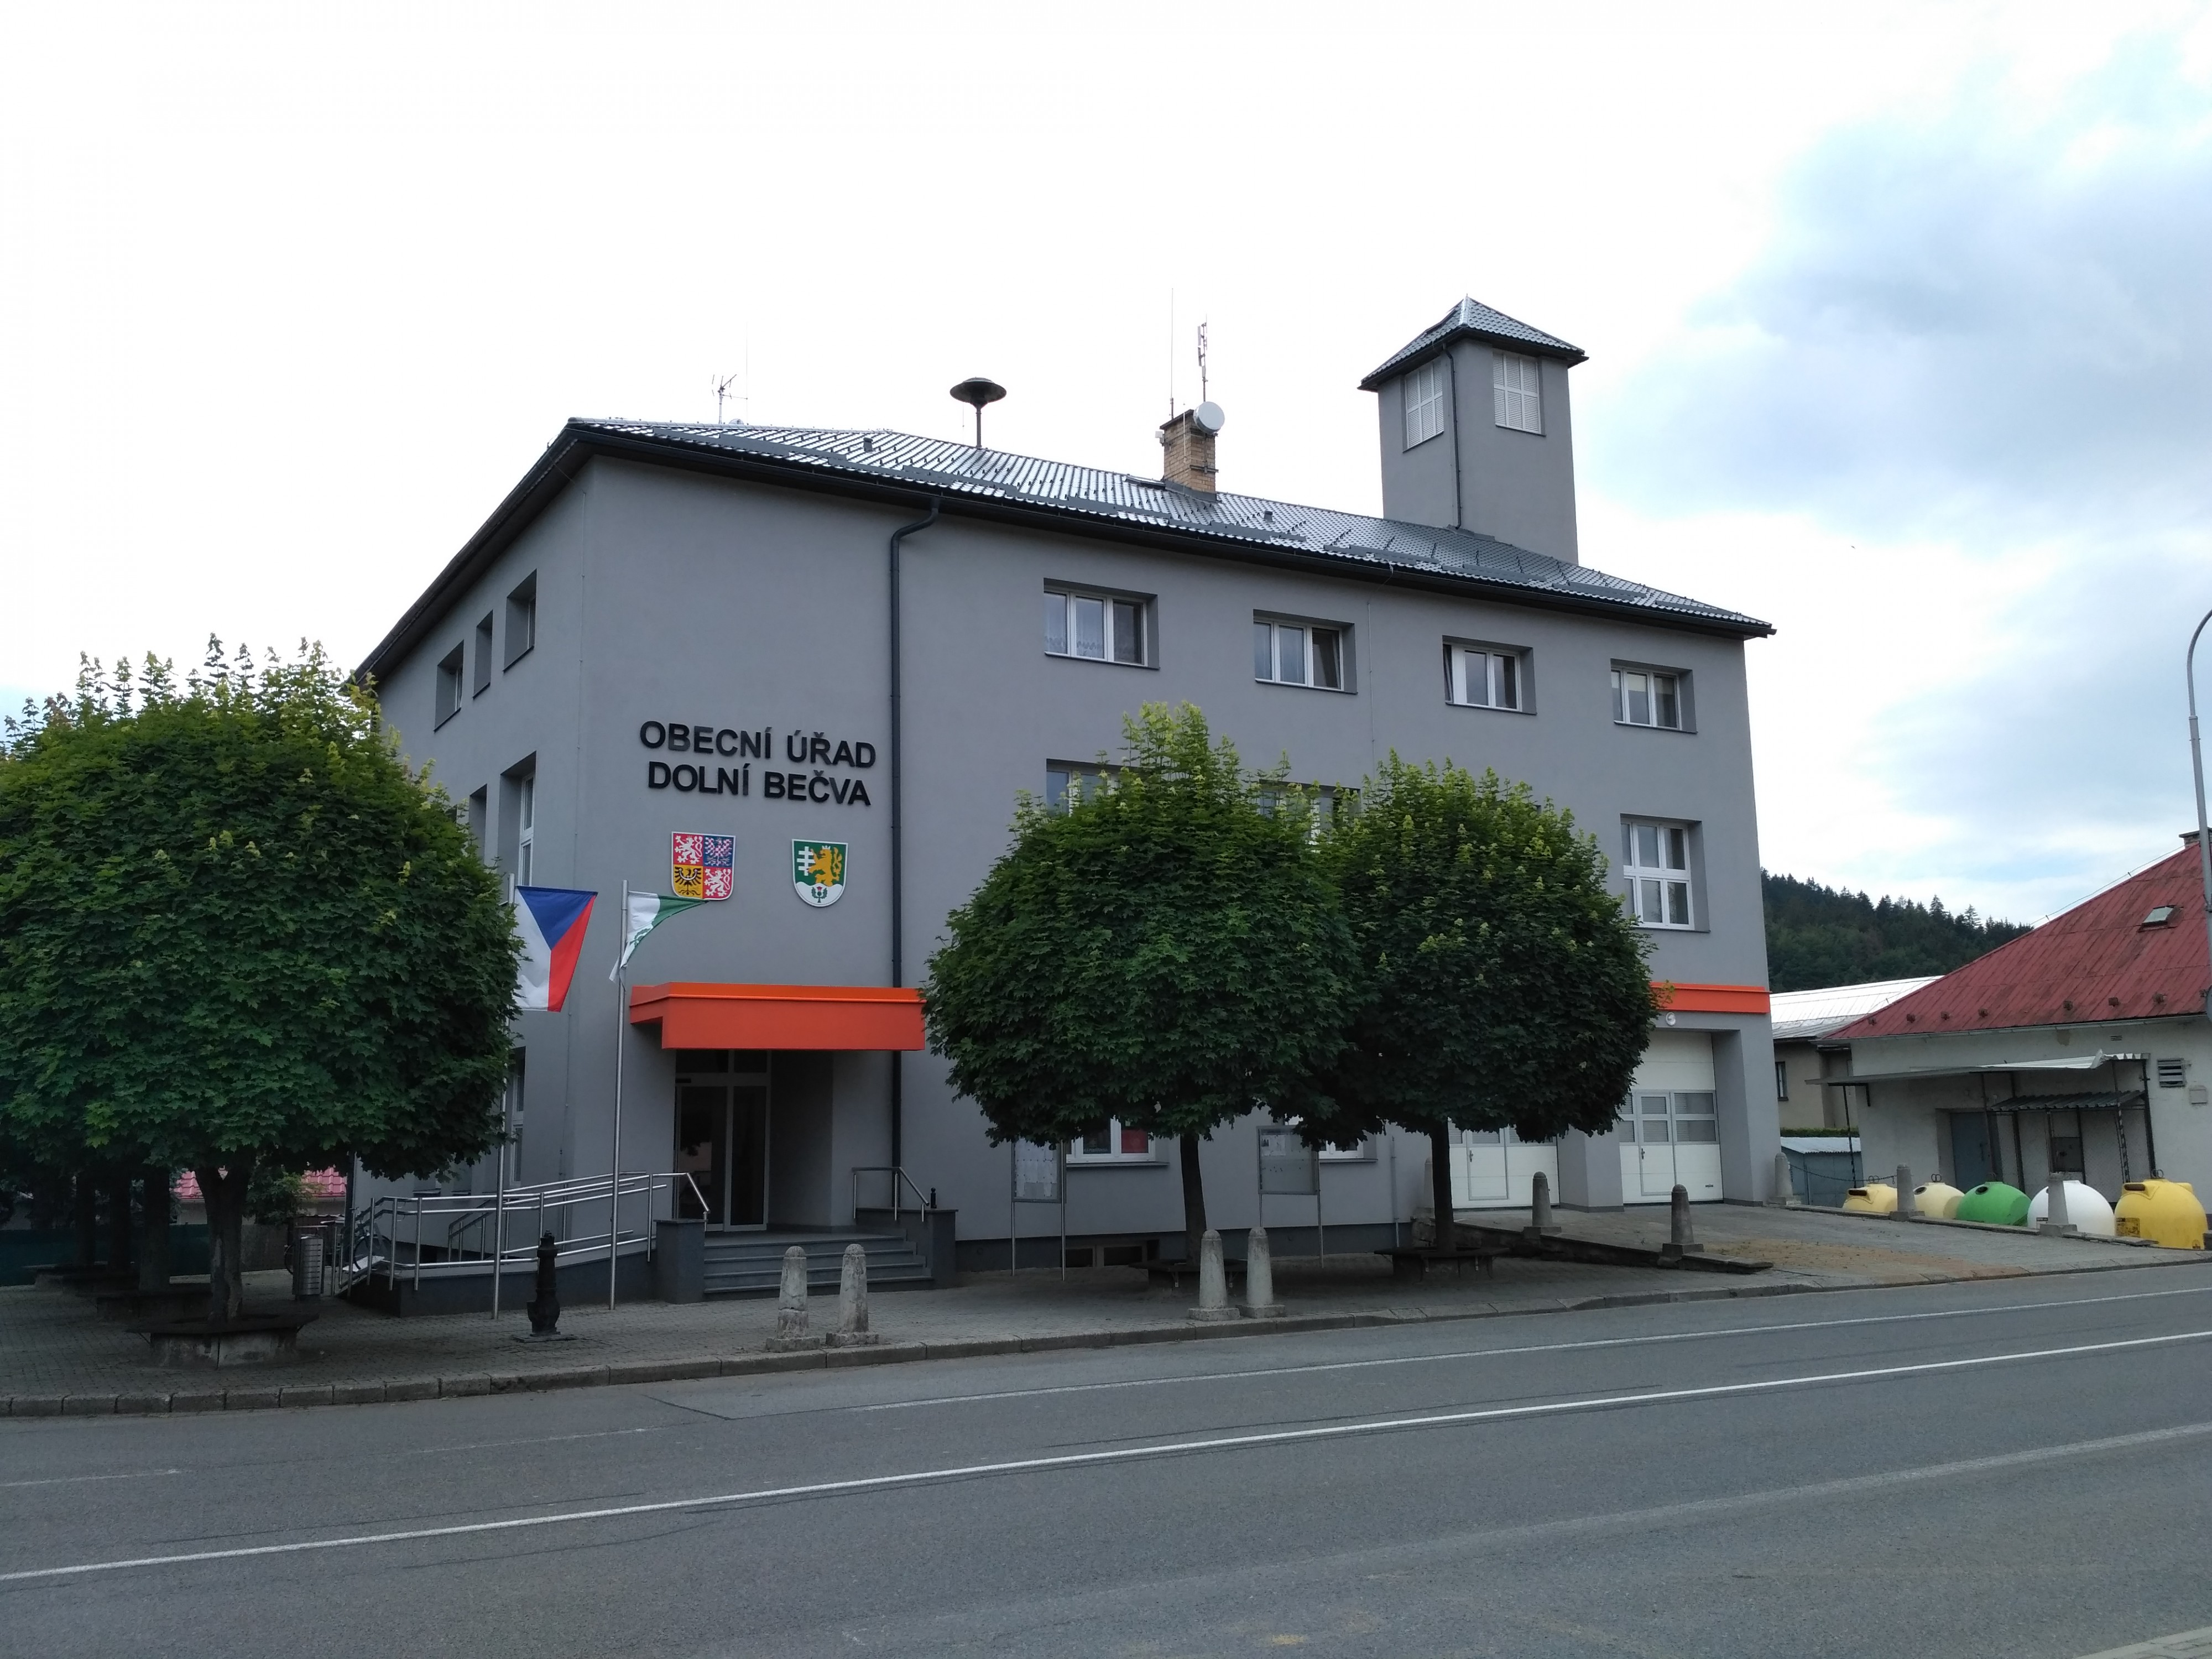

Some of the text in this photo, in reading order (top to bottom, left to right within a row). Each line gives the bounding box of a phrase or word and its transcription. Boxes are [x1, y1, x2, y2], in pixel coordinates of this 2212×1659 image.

[640, 721, 876, 768] OBECNÍ ÚŘAD
[648, 761, 871, 806] DOLNÍ BEČVA
